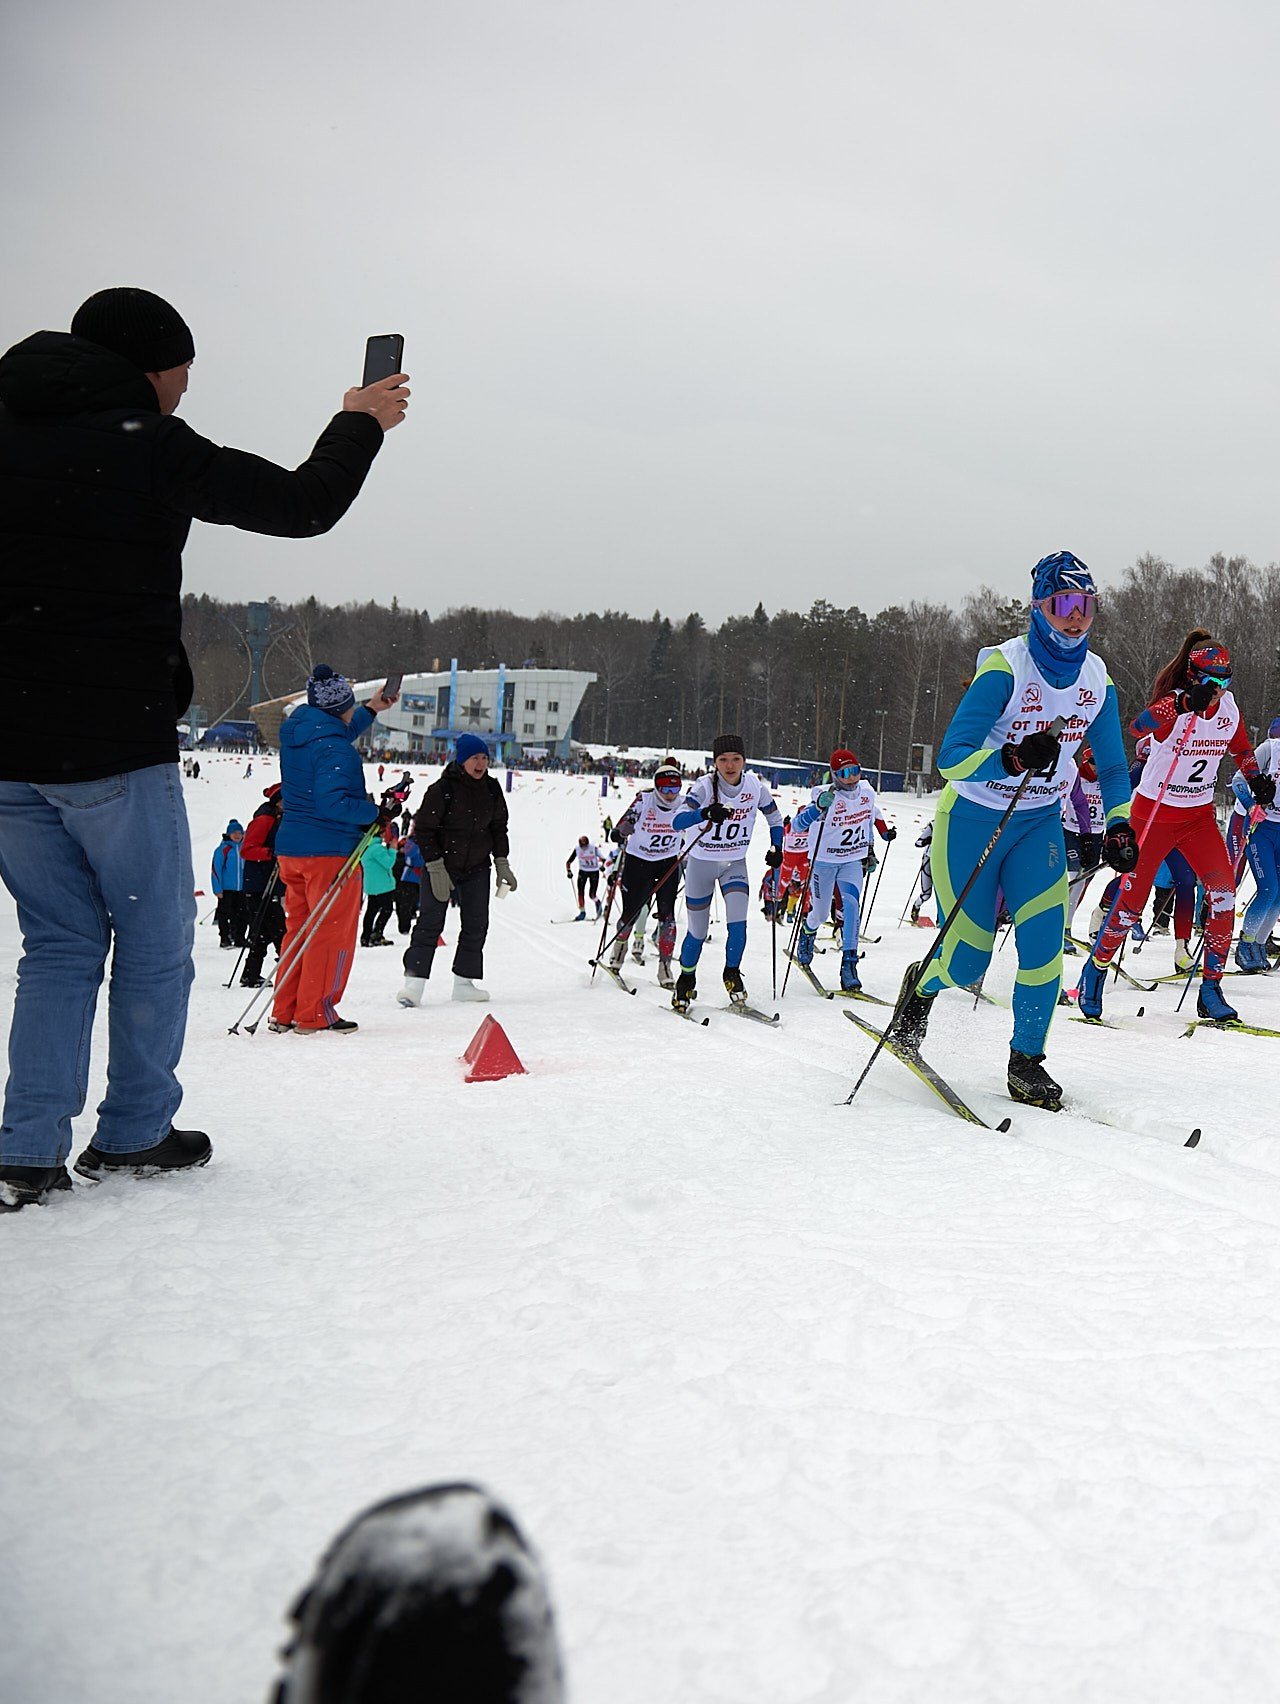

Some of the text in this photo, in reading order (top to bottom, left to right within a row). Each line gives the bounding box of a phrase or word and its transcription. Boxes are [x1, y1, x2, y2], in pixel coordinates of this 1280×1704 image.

[1012, 721, 1030, 731] ОТ
[1007, 732, 1017, 742] К
[1187, 759, 1208, 783] 2
[1089, 806, 1098, 819] 8
[711, 823, 748, 841] 10 1
[650, 834, 672, 848] 20
